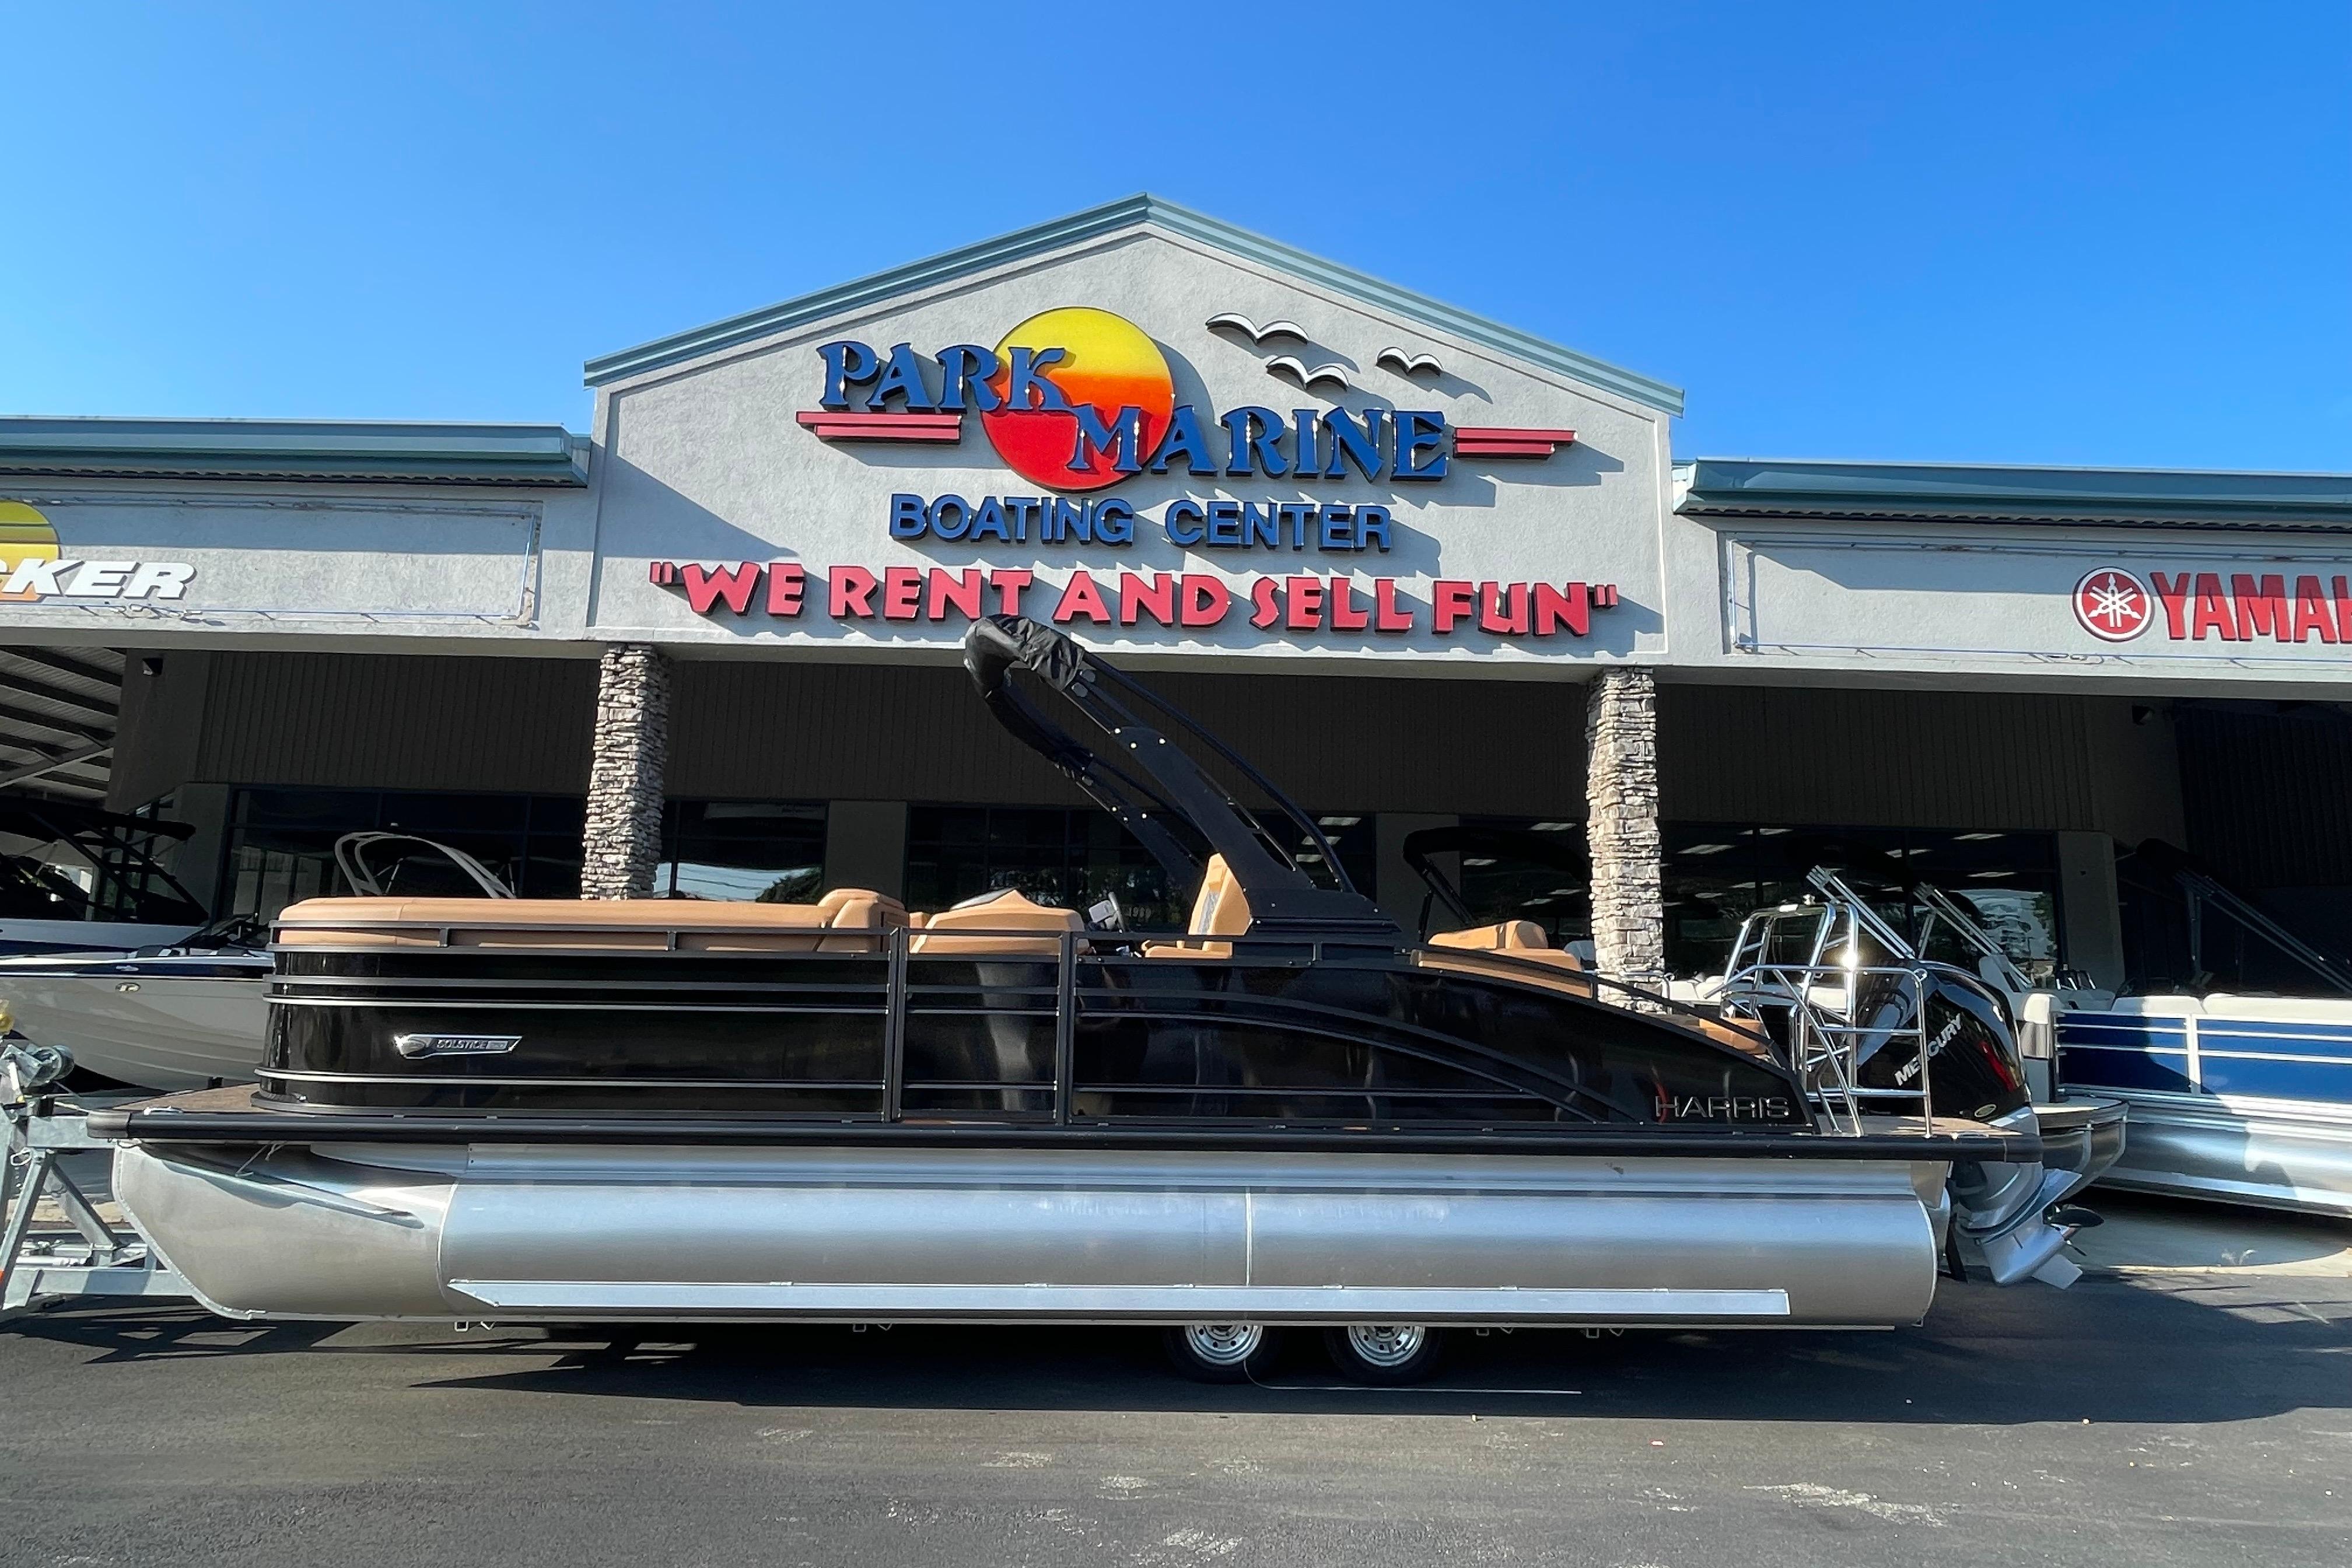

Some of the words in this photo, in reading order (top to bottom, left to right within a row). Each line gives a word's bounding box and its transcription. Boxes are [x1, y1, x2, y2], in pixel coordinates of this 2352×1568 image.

[816, 341, 1078, 413] PARK
[1066, 405, 1448, 481] MARINE
[889, 494, 1134, 547] BOATING
[1165, 499, 1392, 552] CENTER
[0, 558, 197, 601] KER
[649, 561, 805, 618] "WE
[828, 565, 1033, 620] RENT
[1052, 570, 1231, 627] AND
[1249, 576, 1413, 633] SELL
[1432, 580, 1618, 636] FUN"
[436, 1039, 487, 1049] SOLSTICE
[1894, 1013, 1962, 1086] MECURY
[1655, 1096, 1790, 1119] HARRIS
